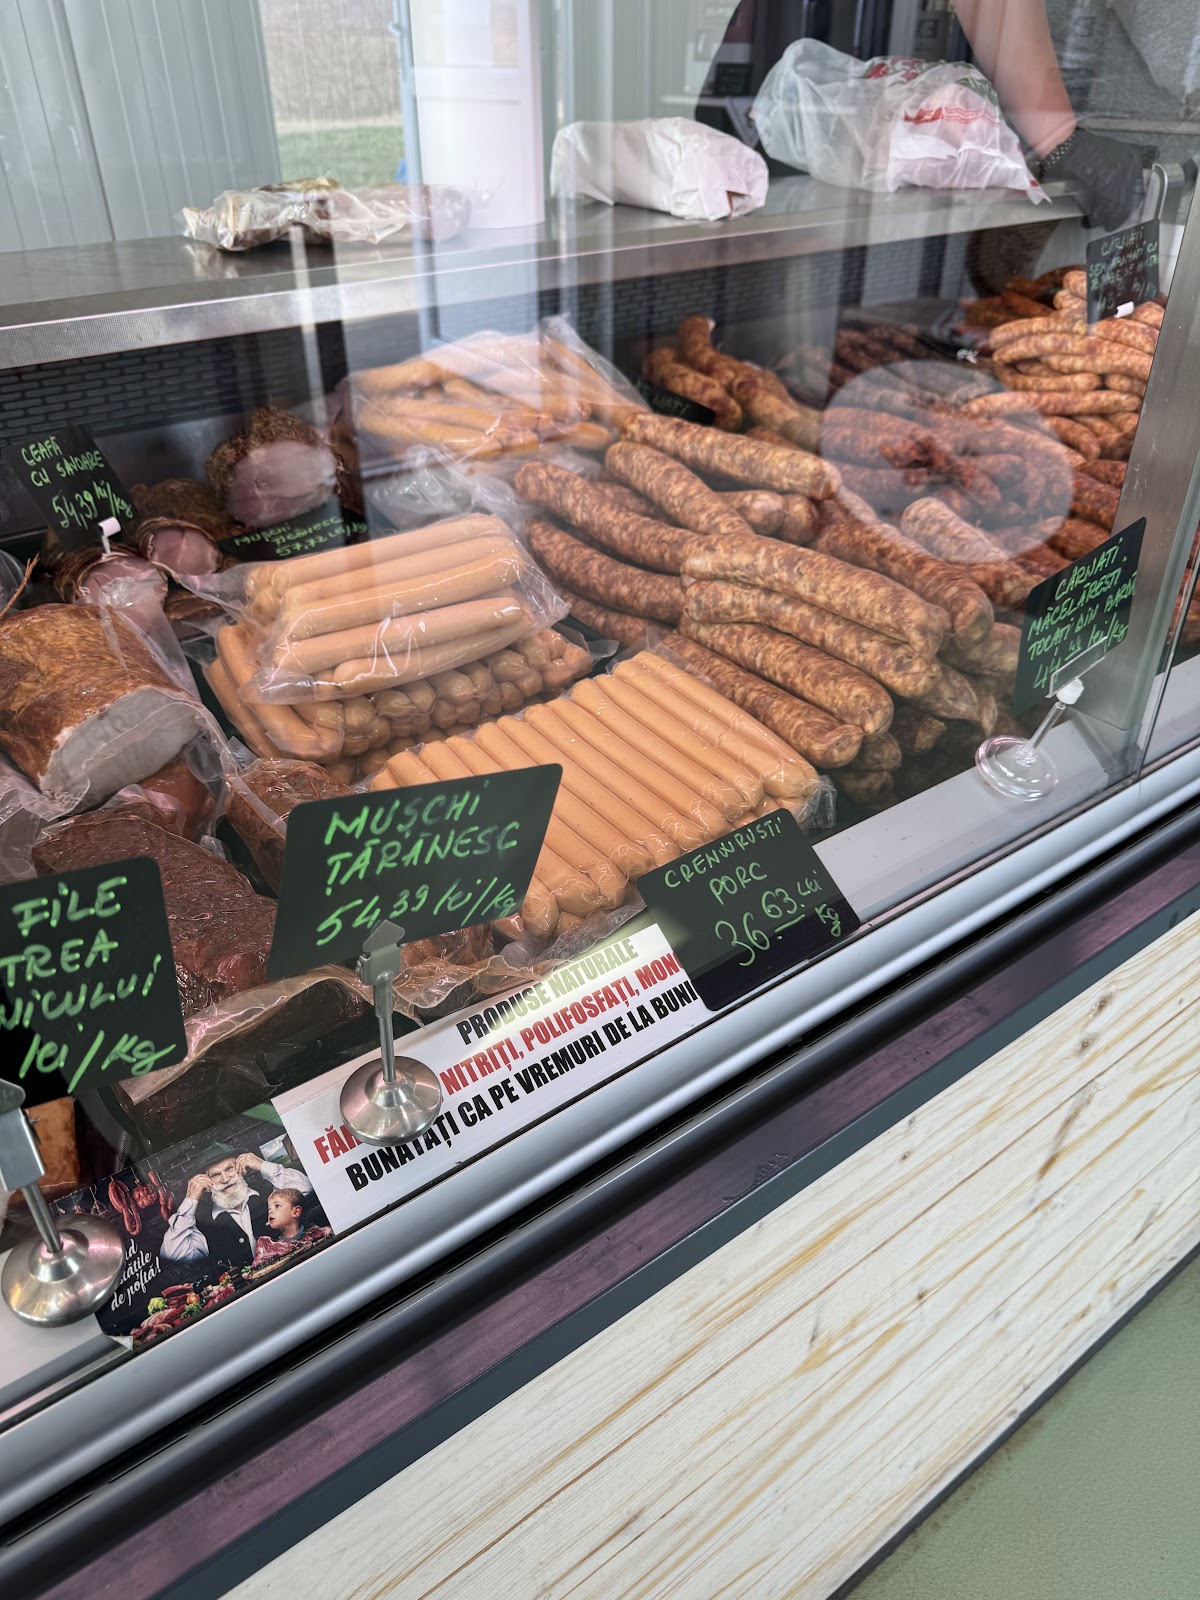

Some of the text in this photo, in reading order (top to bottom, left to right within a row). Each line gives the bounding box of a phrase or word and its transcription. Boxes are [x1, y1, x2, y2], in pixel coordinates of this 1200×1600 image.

[31, 450, 104, 487] CU SAVOARE
[324, 779, 490, 846] MUȘCHI
[12, 876, 127, 937] FILE
[709, 862, 767, 905] PORC
[456, 938, 639, 1046] PRODUSE NATURALE
[457, 1093, 493, 1128] CA
[487, 1077, 520, 1111] PE
[514, 1030, 607, 1095] VREMURI
[601, 1016, 632, 1047] DE
[626, 1004, 656, 1033] LA
[650, 980, 699, 1020] BUNI
[111, 1291, 126, 1311] de
